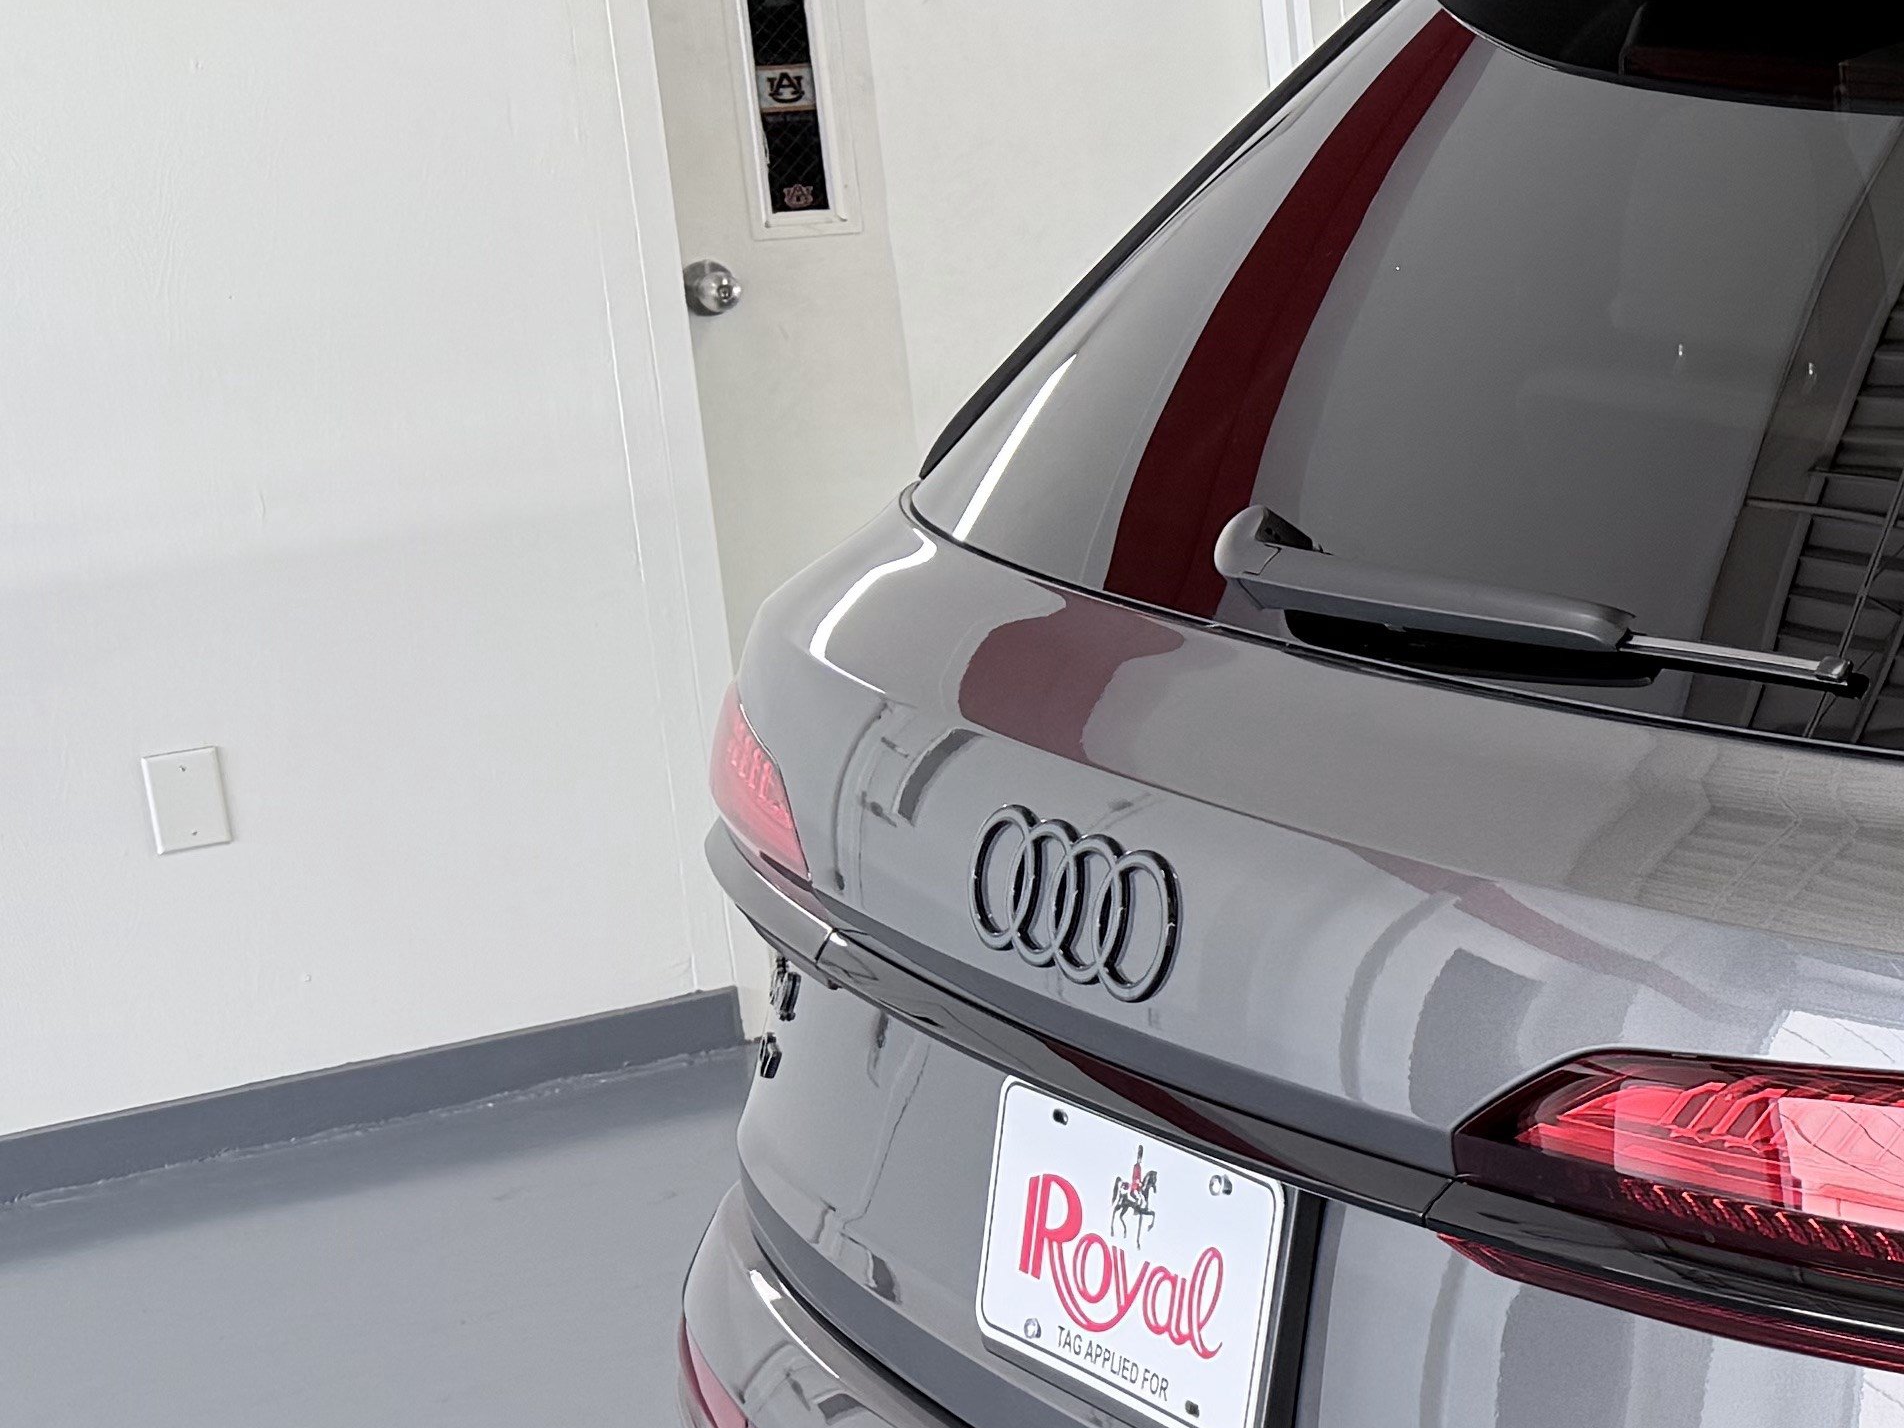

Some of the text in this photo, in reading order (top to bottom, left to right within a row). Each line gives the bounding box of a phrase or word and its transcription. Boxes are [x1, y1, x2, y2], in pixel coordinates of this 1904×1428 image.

[1018, 1173, 1225, 1360] Royal
[1056, 1324, 1170, 1402] TAG APPLIED FOR
